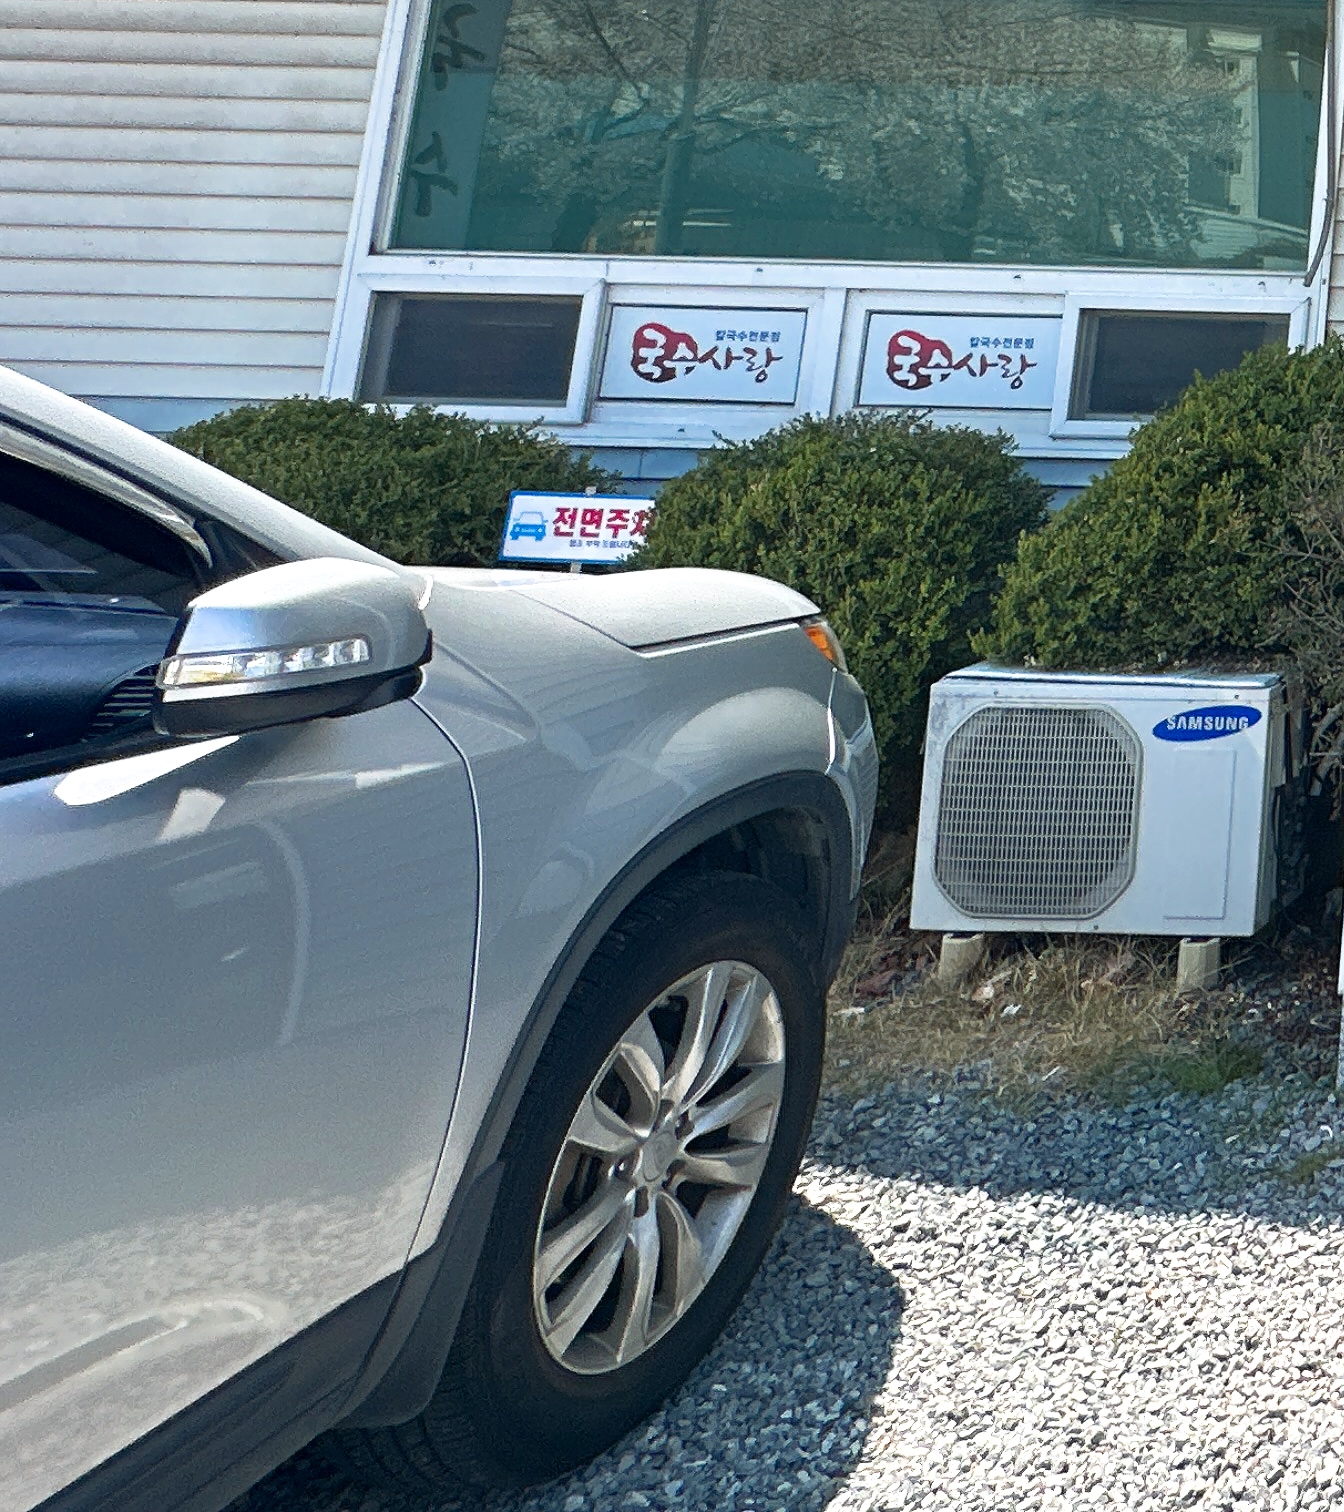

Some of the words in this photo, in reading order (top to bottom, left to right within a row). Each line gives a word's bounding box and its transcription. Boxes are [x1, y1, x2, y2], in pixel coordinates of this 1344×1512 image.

[631, 322, 784, 383] 국수사랑
[886, 329, 1038, 390] 국수사랑
[1166, 713, 1250, 731] SAMSUNG
